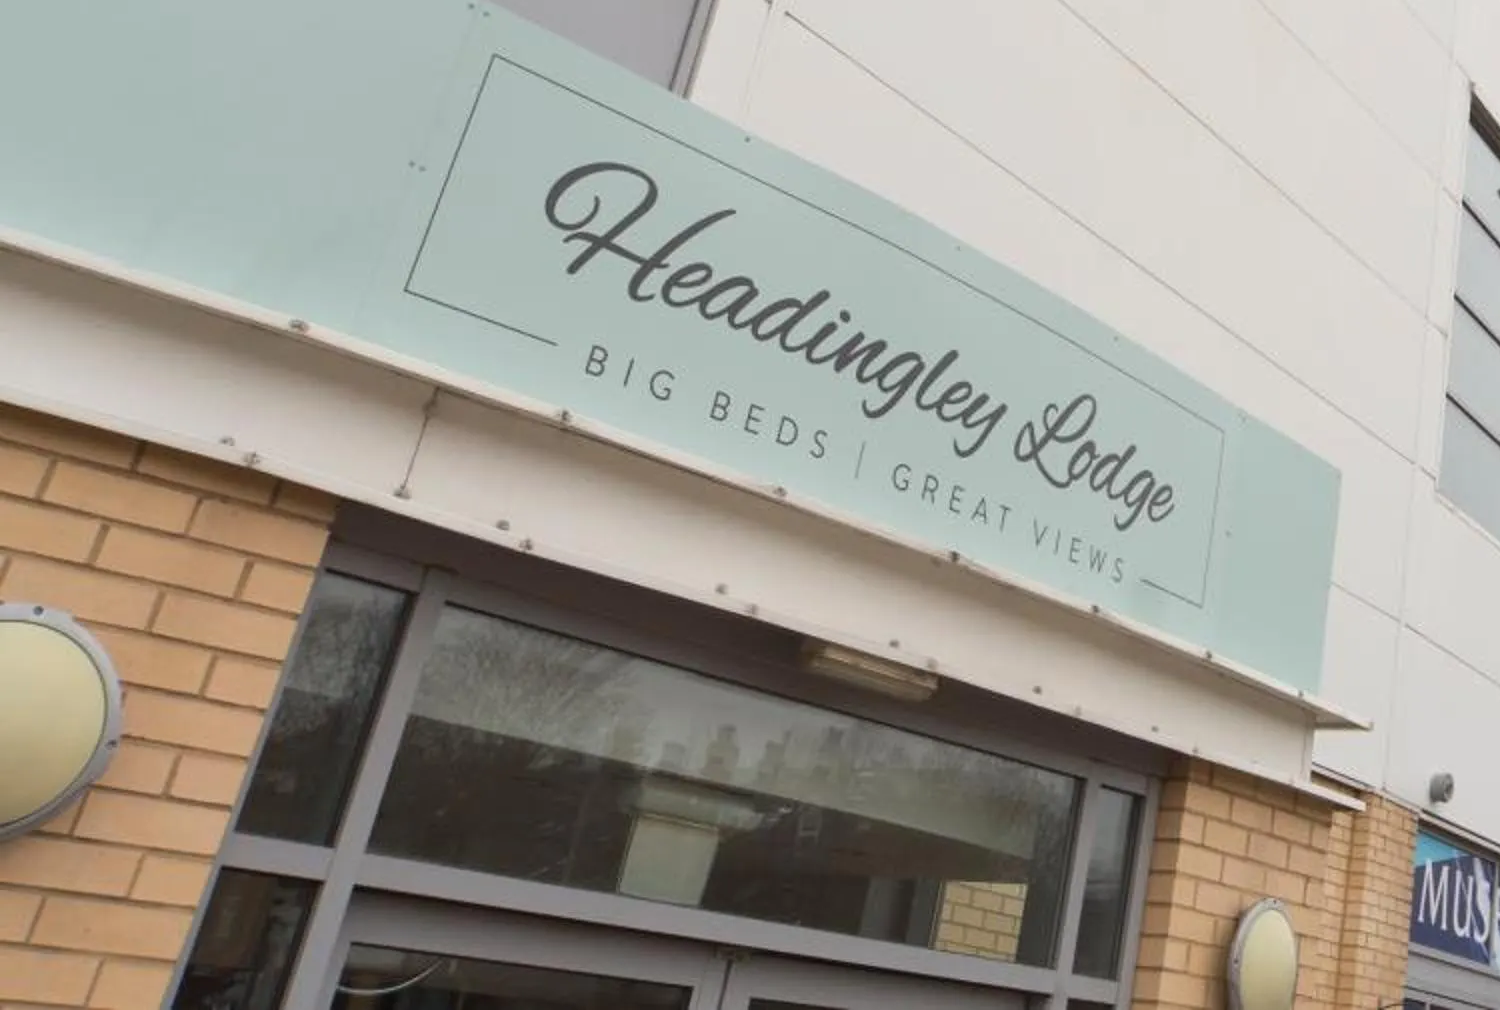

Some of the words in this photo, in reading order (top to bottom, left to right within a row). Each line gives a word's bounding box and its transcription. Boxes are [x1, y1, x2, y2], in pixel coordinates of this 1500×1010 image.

[543, 161, 1007, 457] Headingley
[1013, 393, 1175, 532] Lodge
[584, 344, 675, 402] BIG
[709, 390, 828, 460] BEDS
[891, 463, 1013, 534] GREAT
[1032, 517, 1126, 583] VIEWS
